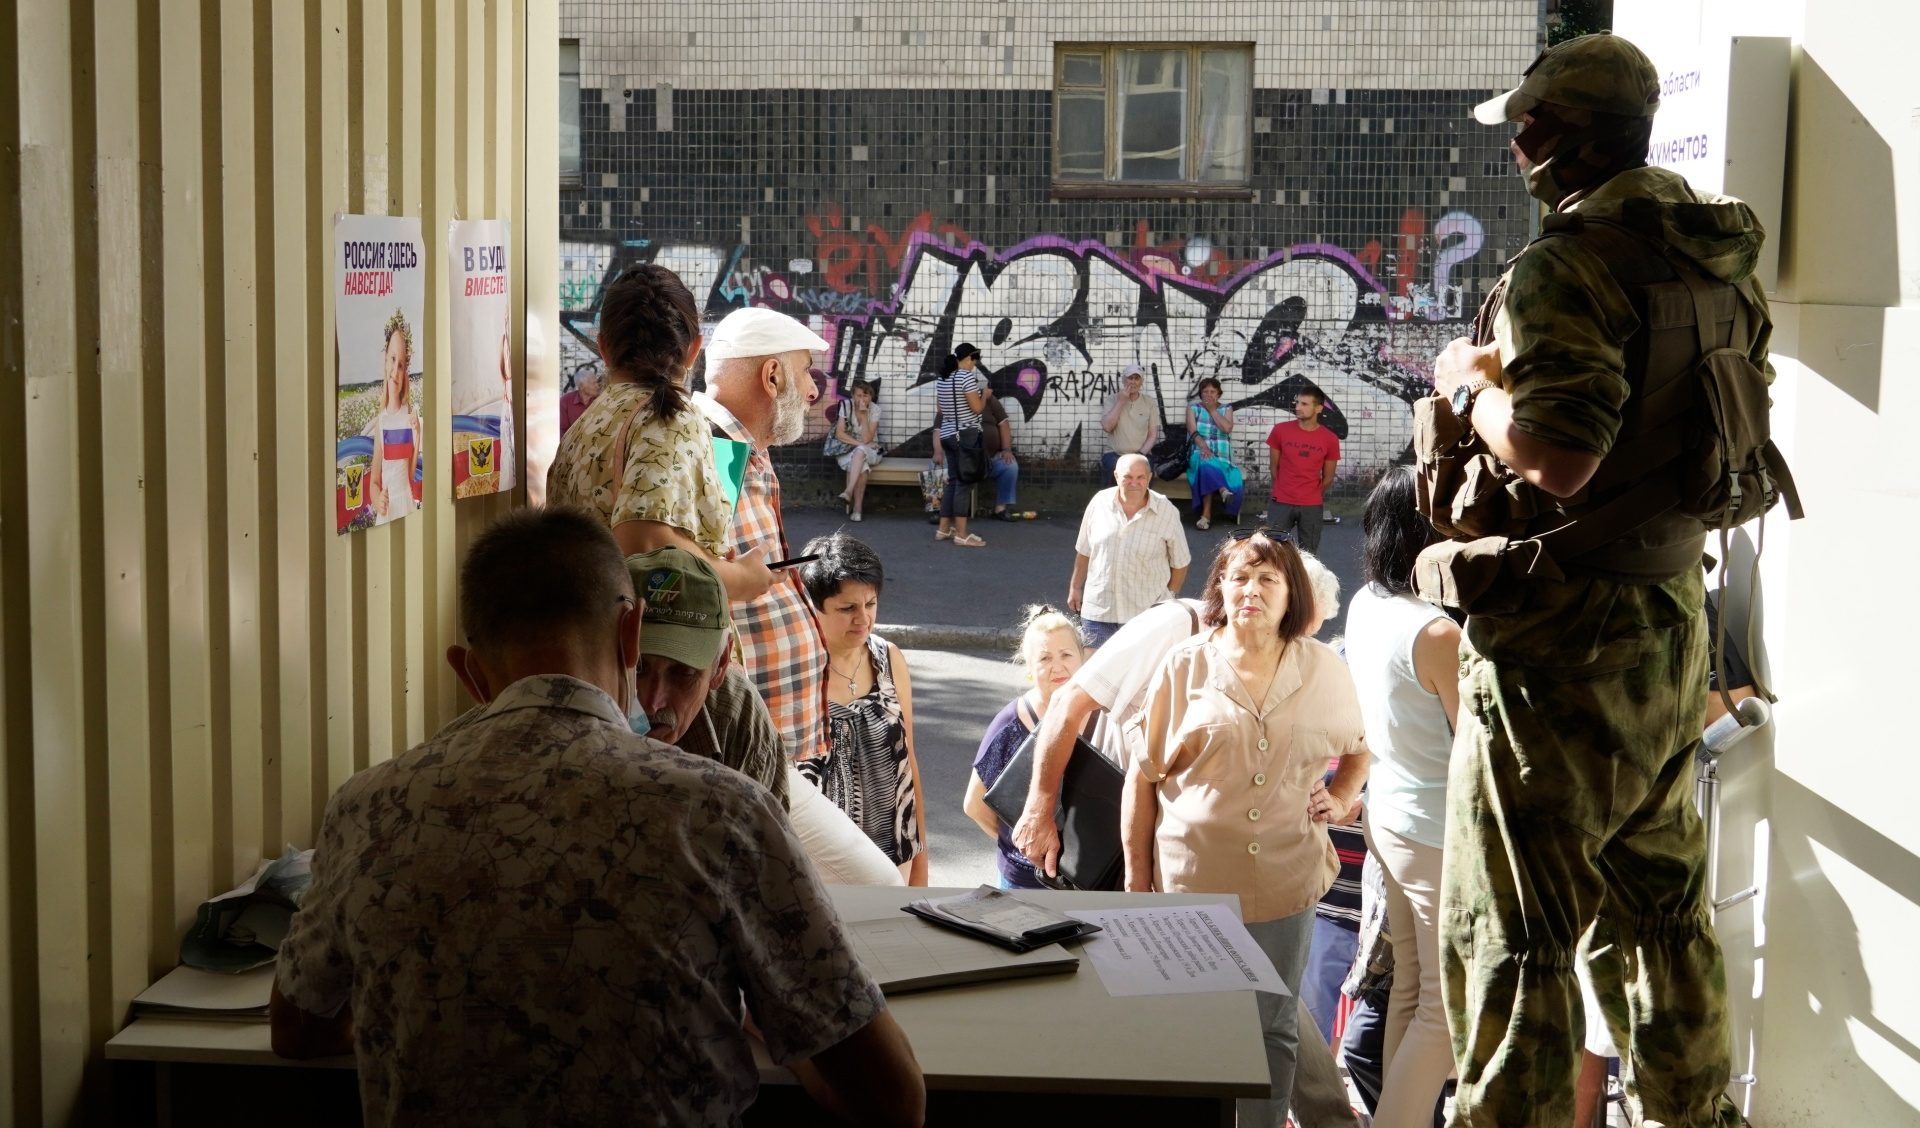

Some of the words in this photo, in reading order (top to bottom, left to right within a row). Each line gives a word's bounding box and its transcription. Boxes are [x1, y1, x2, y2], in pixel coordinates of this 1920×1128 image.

[1663, 71, 1701, 97] области
[1645, 134, 1708, 167] кументов
[344, 241, 385, 269] РОССИЯ
[387, 242, 417, 271] ЗДЕСЬ
[463, 246, 475, 271] В
[344, 271, 394, 297] НАВСЕГДА!
[1285, 441, 1323, 452] ALPHA
